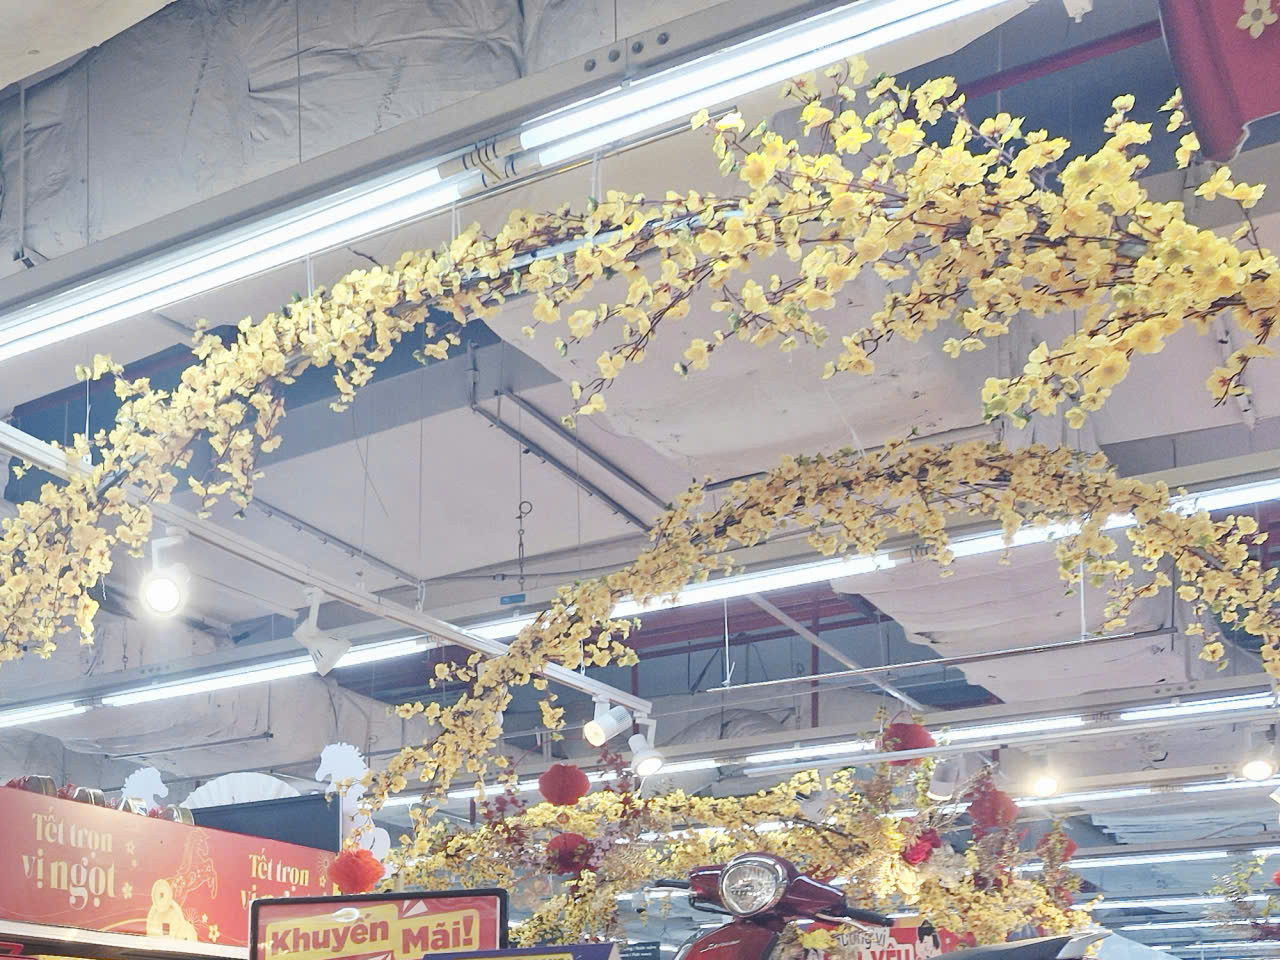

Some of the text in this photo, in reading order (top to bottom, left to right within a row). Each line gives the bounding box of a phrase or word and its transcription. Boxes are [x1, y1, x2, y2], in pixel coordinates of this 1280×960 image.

[32, 806, 113, 858] Tết trọn
[22, 849, 117, 910] vị ngọt
[248, 848, 310, 891] Tết trọn
[271, 913, 474, 956] Khuyến Mãi!
